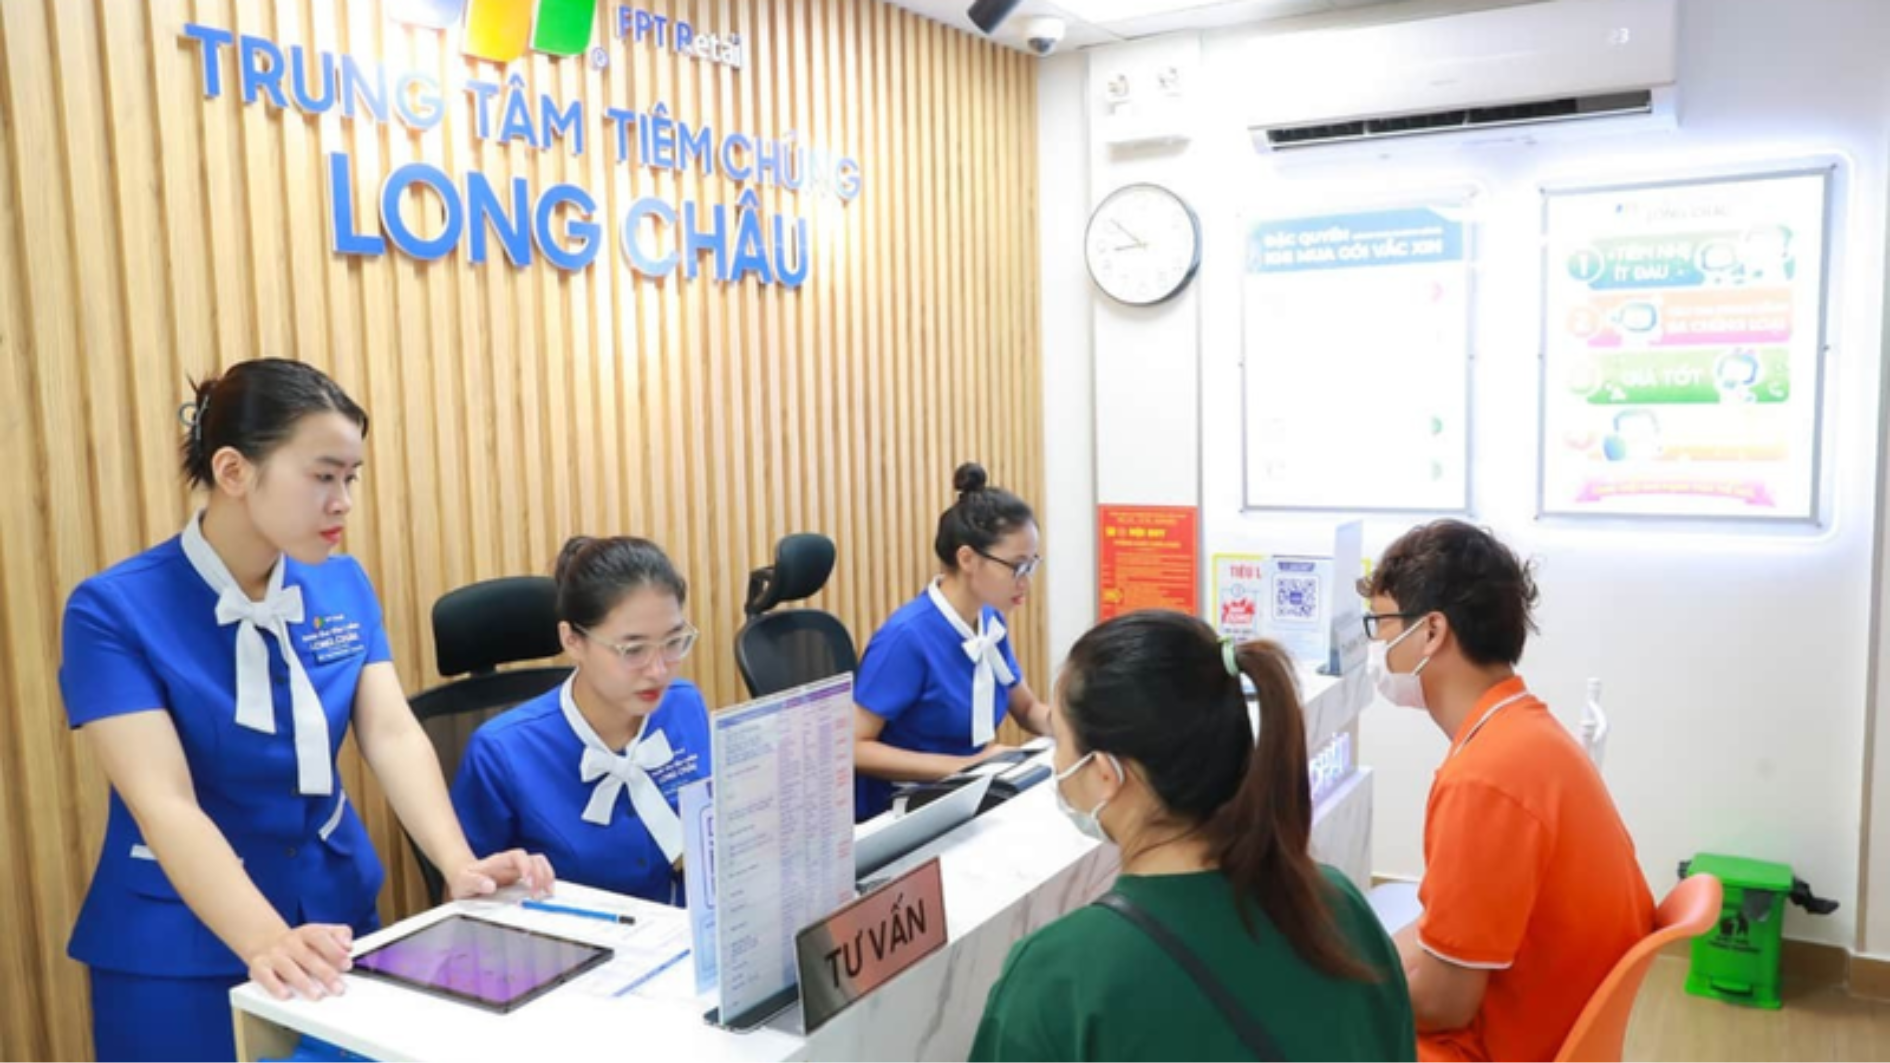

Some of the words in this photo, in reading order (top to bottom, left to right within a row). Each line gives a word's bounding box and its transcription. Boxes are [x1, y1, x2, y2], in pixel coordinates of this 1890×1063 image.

[618, 5, 667, 47] FPT
[676, 21, 742, 68] Retail
[181, 22, 446, 132] TRUNG
[465, 76, 585, 156] TÂM
[605, 102, 713, 176] TIÊM
[328, 151, 604, 272] LONG
[621, 189, 809, 290] CHÂU
[824, 928, 867, 988] TƯ
[867, 894, 927, 960] VẤN
